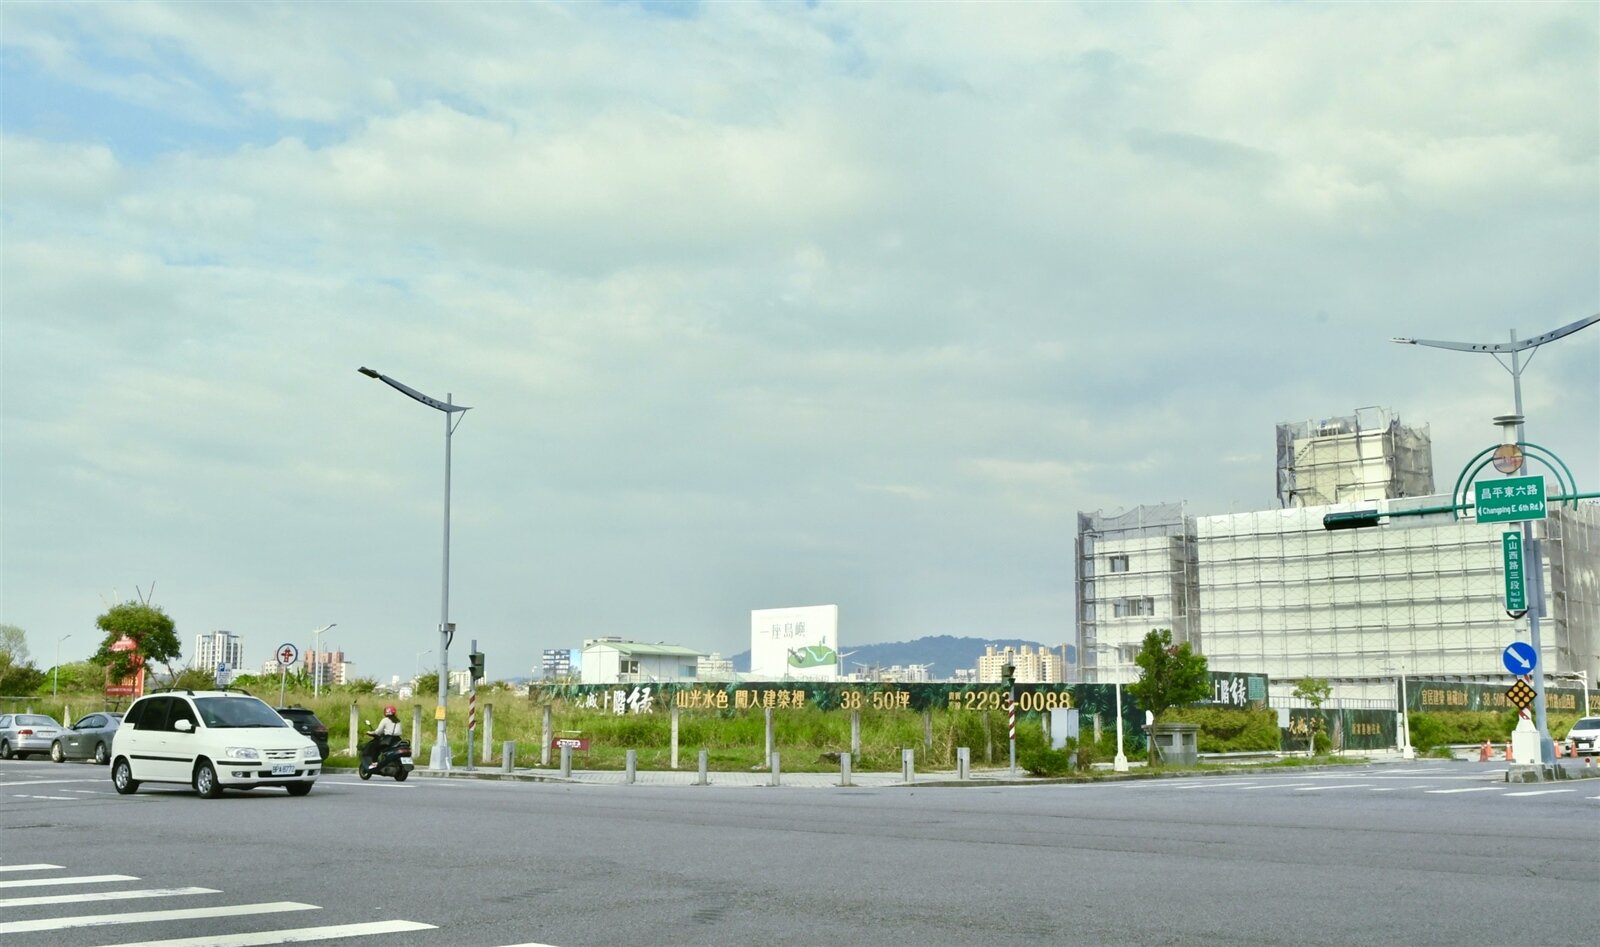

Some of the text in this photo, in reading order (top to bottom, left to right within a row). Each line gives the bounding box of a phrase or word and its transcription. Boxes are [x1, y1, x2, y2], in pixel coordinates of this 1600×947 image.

[1481, 484, 1538, 500] 昌平東六路
[1482, 505, 1511, 515] Changping
[1518, 503, 1529, 512] 6th
[1509, 541, 1520, 590] 山西路三段
[676, 689, 806, 709] 山光水色 闖入建築裡
[965, 692, 1071, 711] 2293-0088
